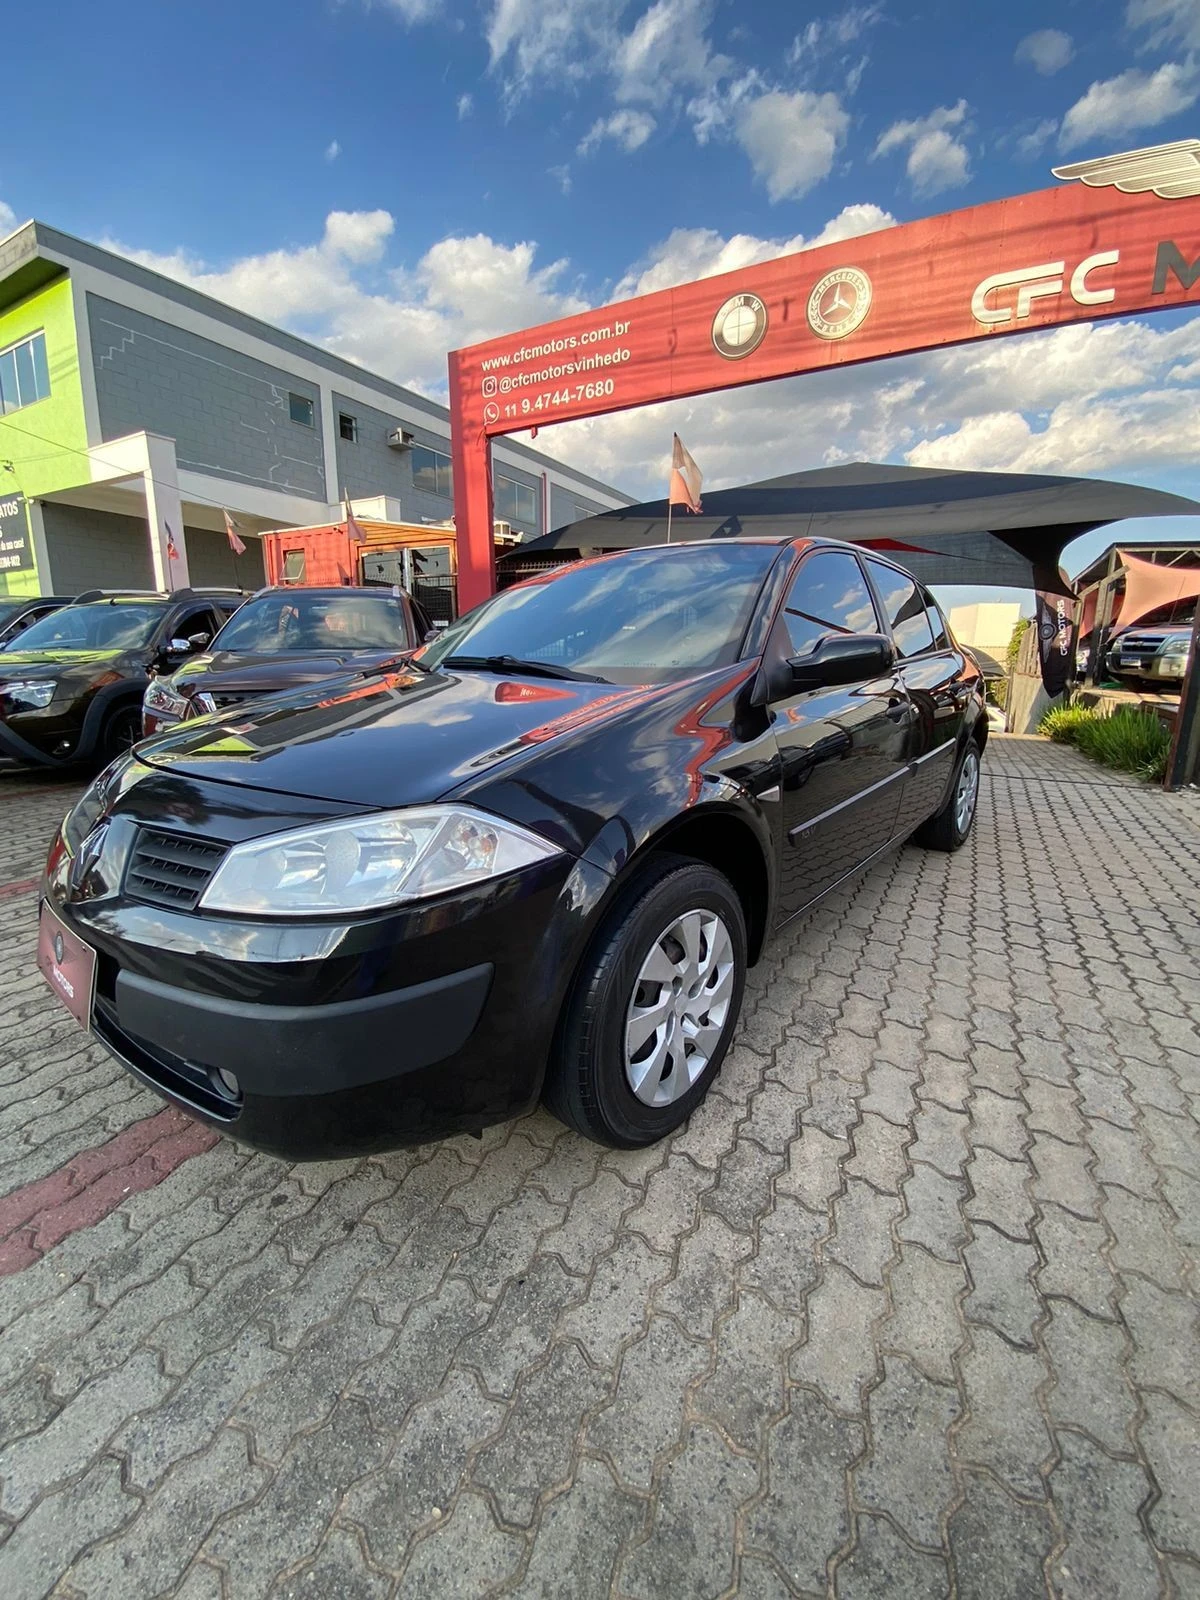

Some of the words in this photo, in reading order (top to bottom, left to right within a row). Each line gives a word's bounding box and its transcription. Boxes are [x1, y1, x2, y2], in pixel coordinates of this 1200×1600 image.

[970, 249, 1120, 324] CFC
[481, 320, 631, 371] www.cfcmotors.com.br
[499, 348, 631, 394] @cfcmotorsvinhedo
[504, 403, 517, 417] 11
[521, 378, 615, 414] 9.4744-7680
[1056, 599, 1067, 639] MOTORS
